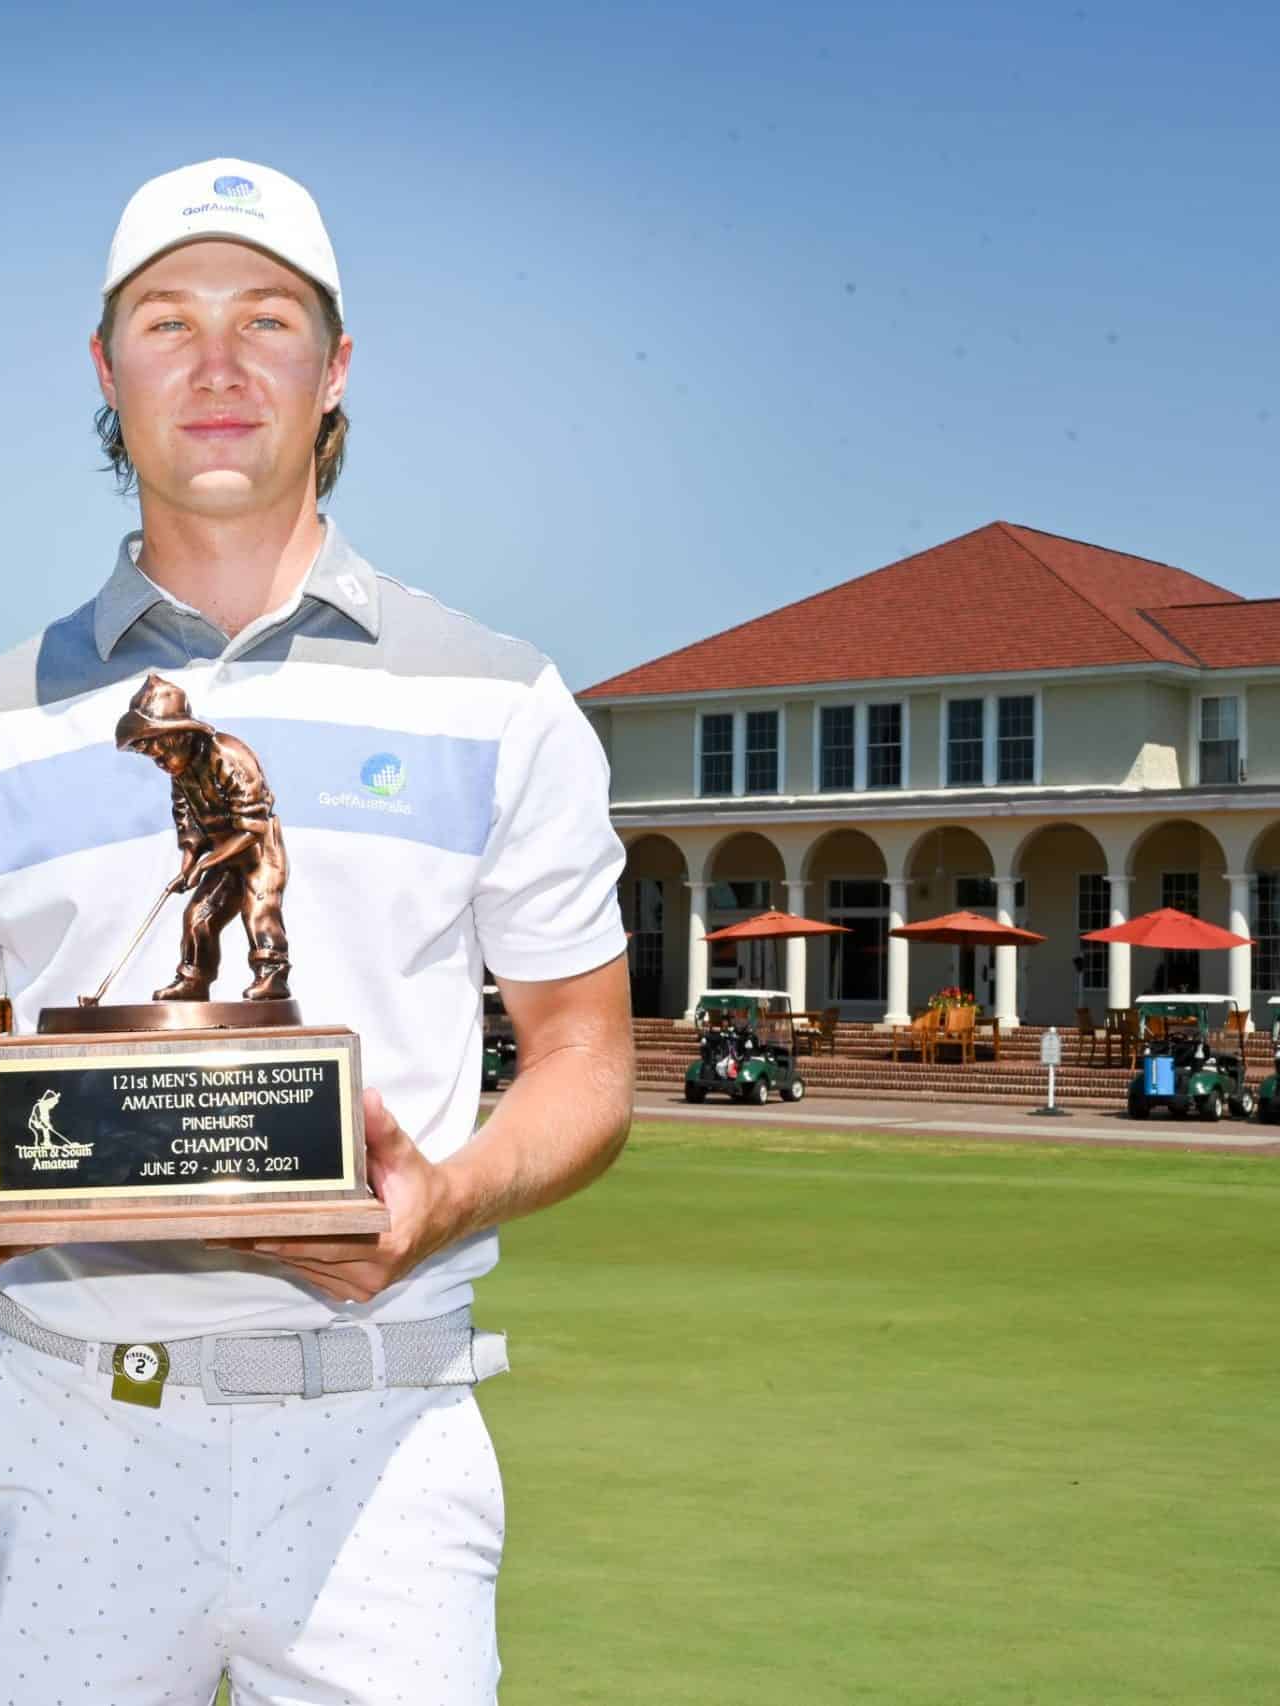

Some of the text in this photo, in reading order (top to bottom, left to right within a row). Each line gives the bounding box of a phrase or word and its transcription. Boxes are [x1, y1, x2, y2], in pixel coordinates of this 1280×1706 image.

[112, 1067, 323, 1090] 121st MEN'S NORTH & SOUTH
[121, 1088, 314, 1111] AMATEUR CHAMPIONSHIP
[182, 1114, 255, 1131] PINEHURST
[61, 1144, 92, 1157] South
[171, 1136, 268, 1154] CHAMPION
[32, 1159, 79, 1170] Amateur
[140, 1161, 176, 1176] JUNE
[179, 1160, 198, 1175] 29
[212, 1159, 243, 1174] JULY
[246, 1158, 259, 1173] 3,
[265, 1156, 299, 1172] 2021
[135, 1359, 146, 1374] 2
